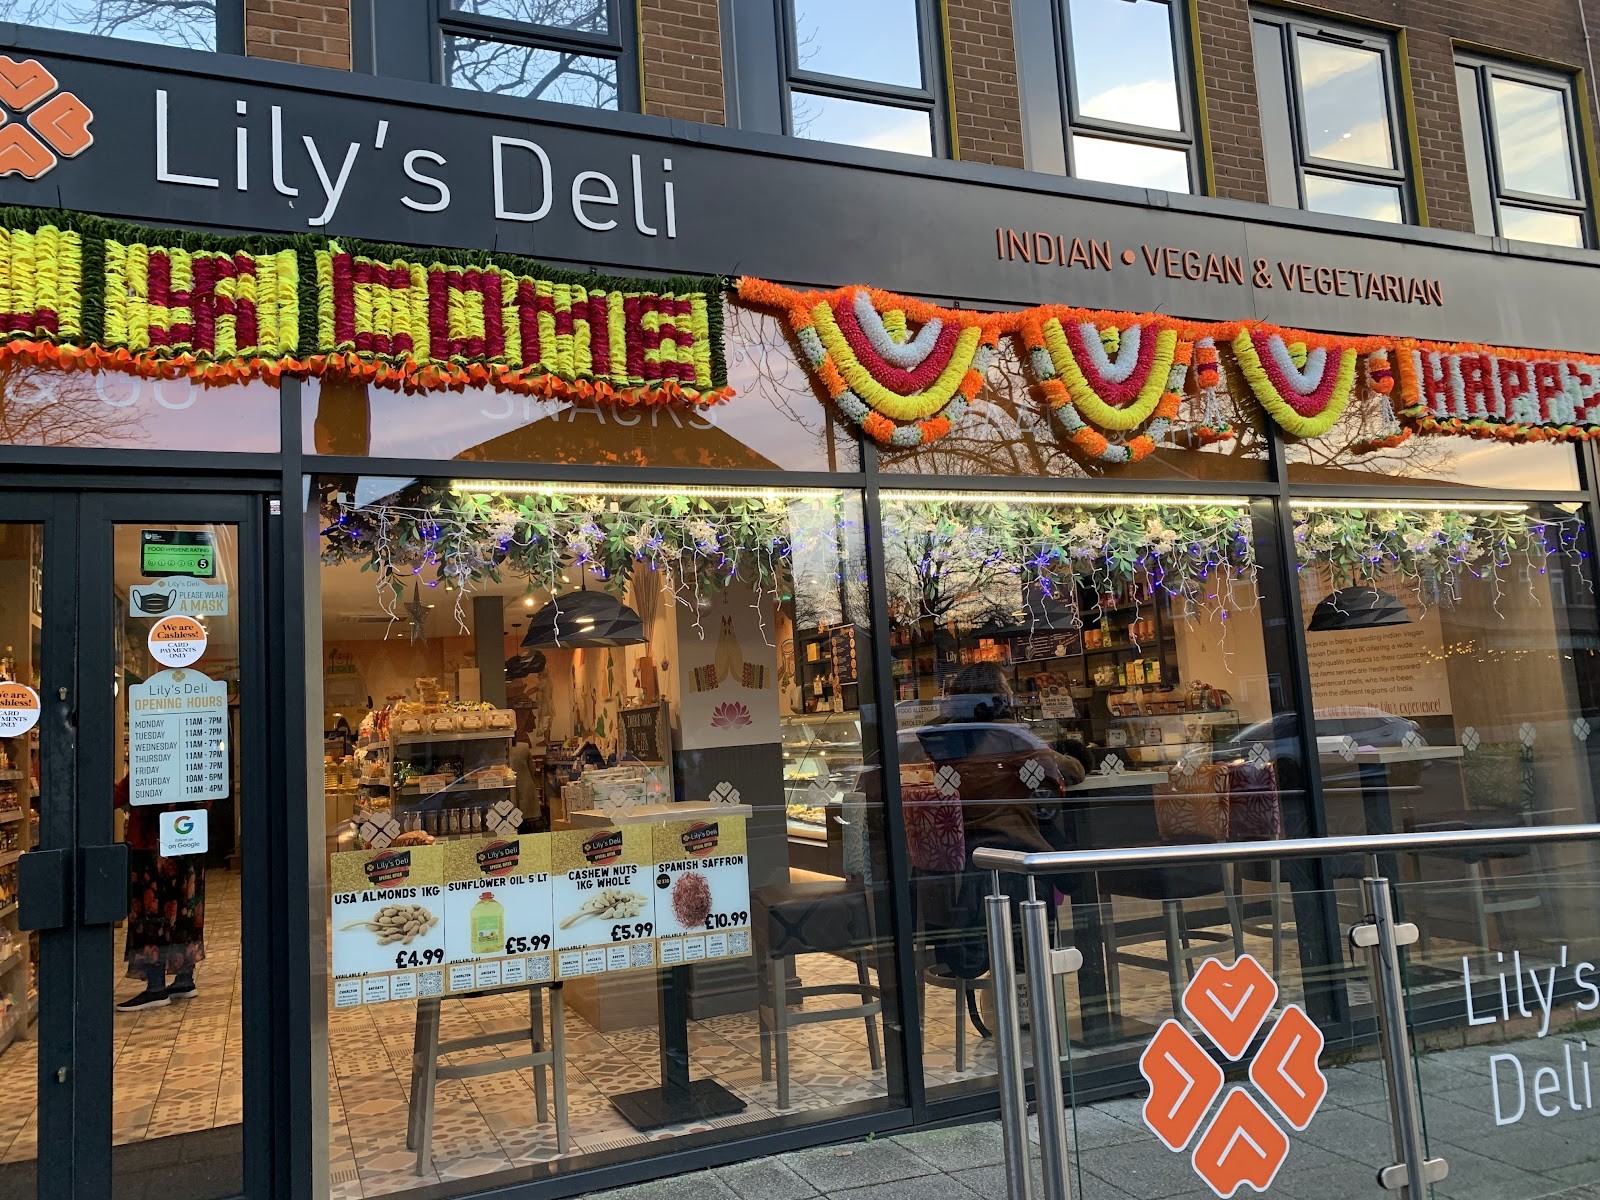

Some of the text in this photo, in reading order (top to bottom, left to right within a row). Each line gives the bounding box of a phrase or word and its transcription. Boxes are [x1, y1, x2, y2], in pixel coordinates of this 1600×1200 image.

[155, 89, 678, 239] Lily's Deli
[996, 228, 1443, 306] INDIAN VEGAN & VEGETARIAN
[200, 560, 206, 568] 5
[180, 600, 224, 612] A MASK
[157, 631, 199, 639] Cashless!
[149, 683, 208, 697] Lily's Deli
[134, 696, 223, 711] OPENING HOURS
[1400, 698, 1440, 715] experience!
[135, 717, 222, 728] MONDAY 11AM 7PM
[135, 728, 222, 740] TUESDAY 11AM 7PM
[135, 742, 178, 752] WEDNESDAY
[186, 740, 203, 748] 11AM
[135, 750, 222, 764] THURSDAY 11AM 7PM
[136, 762, 222, 775] FRIDAY 11AM 7PM
[136, 776, 171, 786] SATURDAY
[186, 774, 203, 782] 10AM
[136, 790, 164, 798] SUNDAY
[186, 786, 204, 794] 11AM
[174, 816, 194, 834] G
[690, 832, 706, 840] Lily's
[178, 841, 200, 850] Google
[505, 846, 518, 854] Deli
[592, 840, 608, 849] Lily's
[376, 858, 408, 870] Lily's Deli
[658, 856, 744, 872] SPANISH SAFFRON
[568, 865, 637, 881] CASHEW NUTS
[448, 873, 548, 892] SUNFLOWER OIL 5 LT
[576, 876, 631, 890] 1KG WHOLE
[334, 886, 440, 904] USA ALMONDS 1KG
[704, 911, 748, 930] £10.99
[610, 922, 654, 942] £5.99
[505, 934, 550, 954] £5.99
[396, 948, 444, 968] £4.99
[1462, 946, 1600, 1126] Lily's Deli
